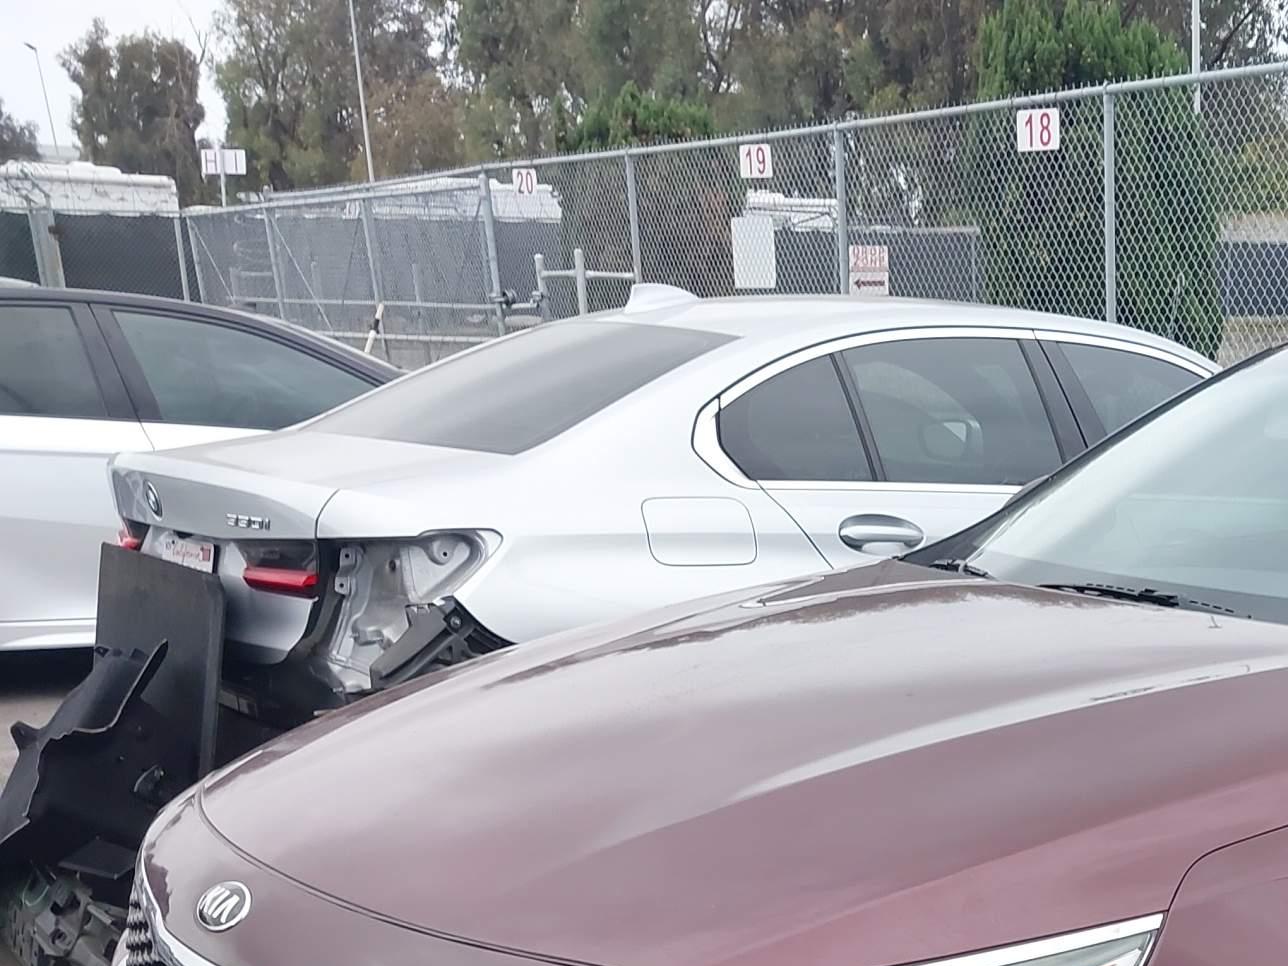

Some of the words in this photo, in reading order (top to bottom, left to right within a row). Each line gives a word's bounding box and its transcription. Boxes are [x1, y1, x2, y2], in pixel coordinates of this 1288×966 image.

[1025, 113, 1051, 148] 18
[746, 146, 766, 176] 19
[516, 171, 534, 194] 20
[200, 886, 240, 923] KIA
